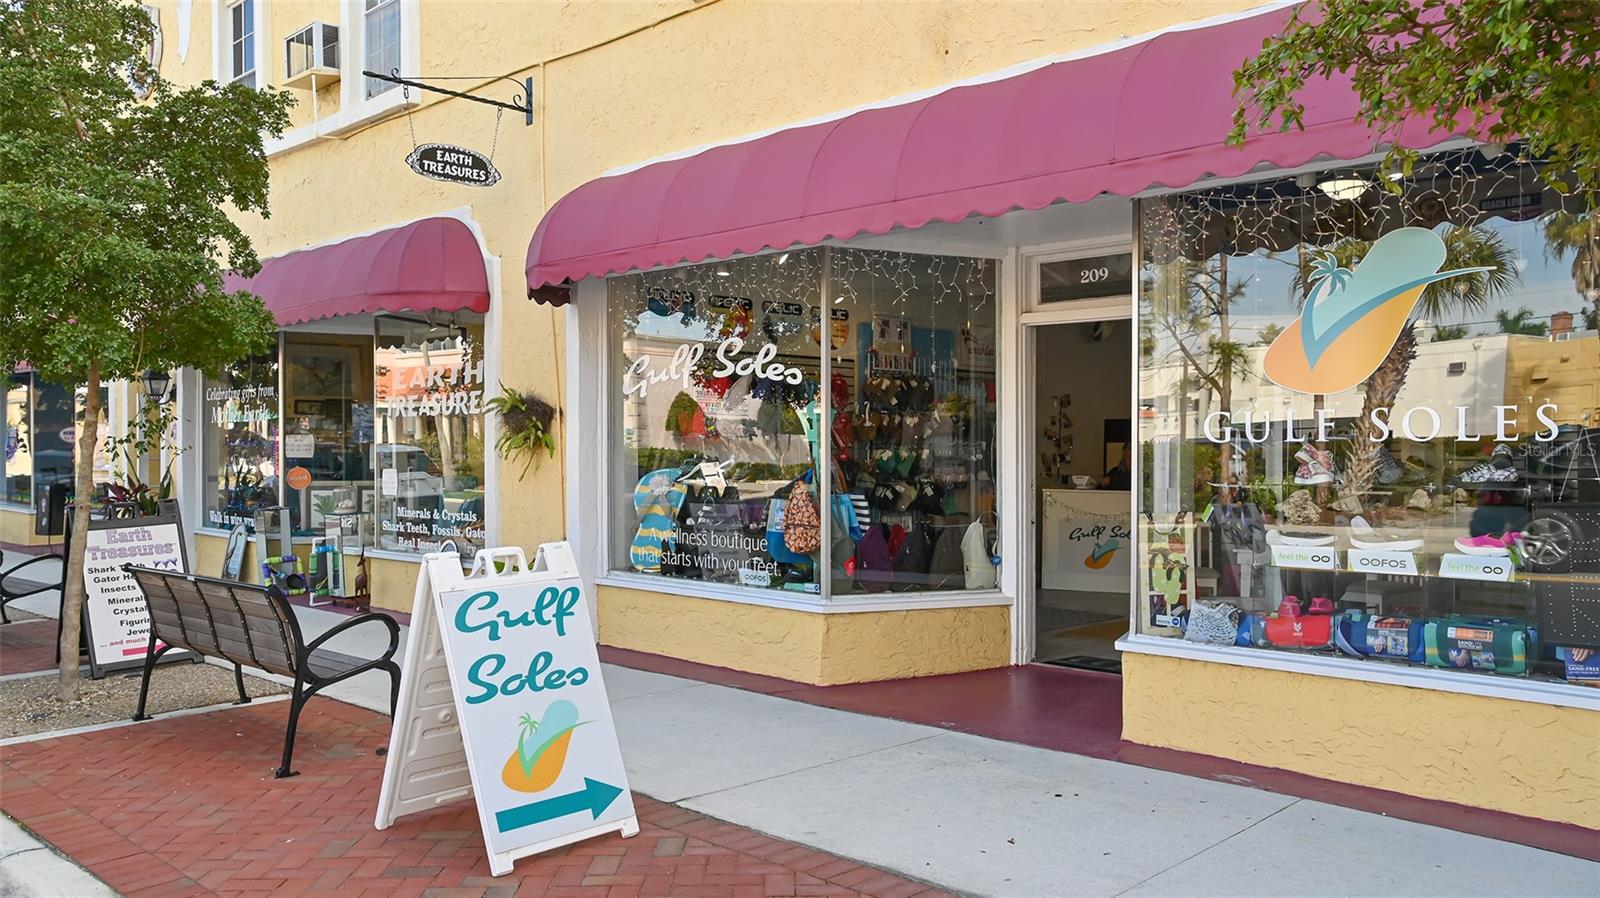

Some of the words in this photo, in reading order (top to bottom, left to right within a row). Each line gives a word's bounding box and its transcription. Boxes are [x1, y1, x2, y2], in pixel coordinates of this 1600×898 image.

[436, 150, 473, 166] EARTH
[422, 160, 486, 181] TREASURES
[1080, 266, 1109, 284] 209
[393, 360, 484, 390] EARTH
[622, 343, 705, 398] Gulf
[713, 337, 803, 385] Soles
[206, 386, 241, 402] Celebrating
[241, 383, 257, 403] gifts
[257, 382, 274, 404] from
[384, 390, 485, 418] TREASURE
[1202, 408, 1337, 444] GULF
[1369, 402, 1560, 443] SOLES
[396, 506, 431, 520] Minerals
[432, 508, 440, 520] &
[441, 509, 477, 523] Crystals
[105, 527, 153, 545] Earth
[382, 520, 405, 533] Shark
[406, 521, 430, 536] Teeth,
[1069, 525, 1106, 542] Gulf
[398, 536, 416, 551] Real
[648, 527, 657, 542] A
[659, 527, 708, 546] wellness
[711, 530, 768, 554] boutique
[87, 543, 174, 561] Treasures
[1278, 552, 1294, 562] feel
[1295, 553, 1309, 562] the
[88, 565, 117, 575] Shark
[638, 546, 660, 563] that
[661, 551, 692, 567] starts
[693, 553, 719, 570] with
[721, 558, 749, 575] your
[752, 558, 782, 578] feet.
[1360, 557, 1407, 569] OOFOS
[1448, 561, 1464, 572] feel
[1465, 561, 1480, 573] the
[93, 575, 121, 584] Gator
[744, 573, 767, 583] OOFOS
[100, 584, 137, 594] Insects
[454, 586, 581, 642] Gulf
[126, 637, 147, 645] much
[465, 651, 589, 705] Soles
